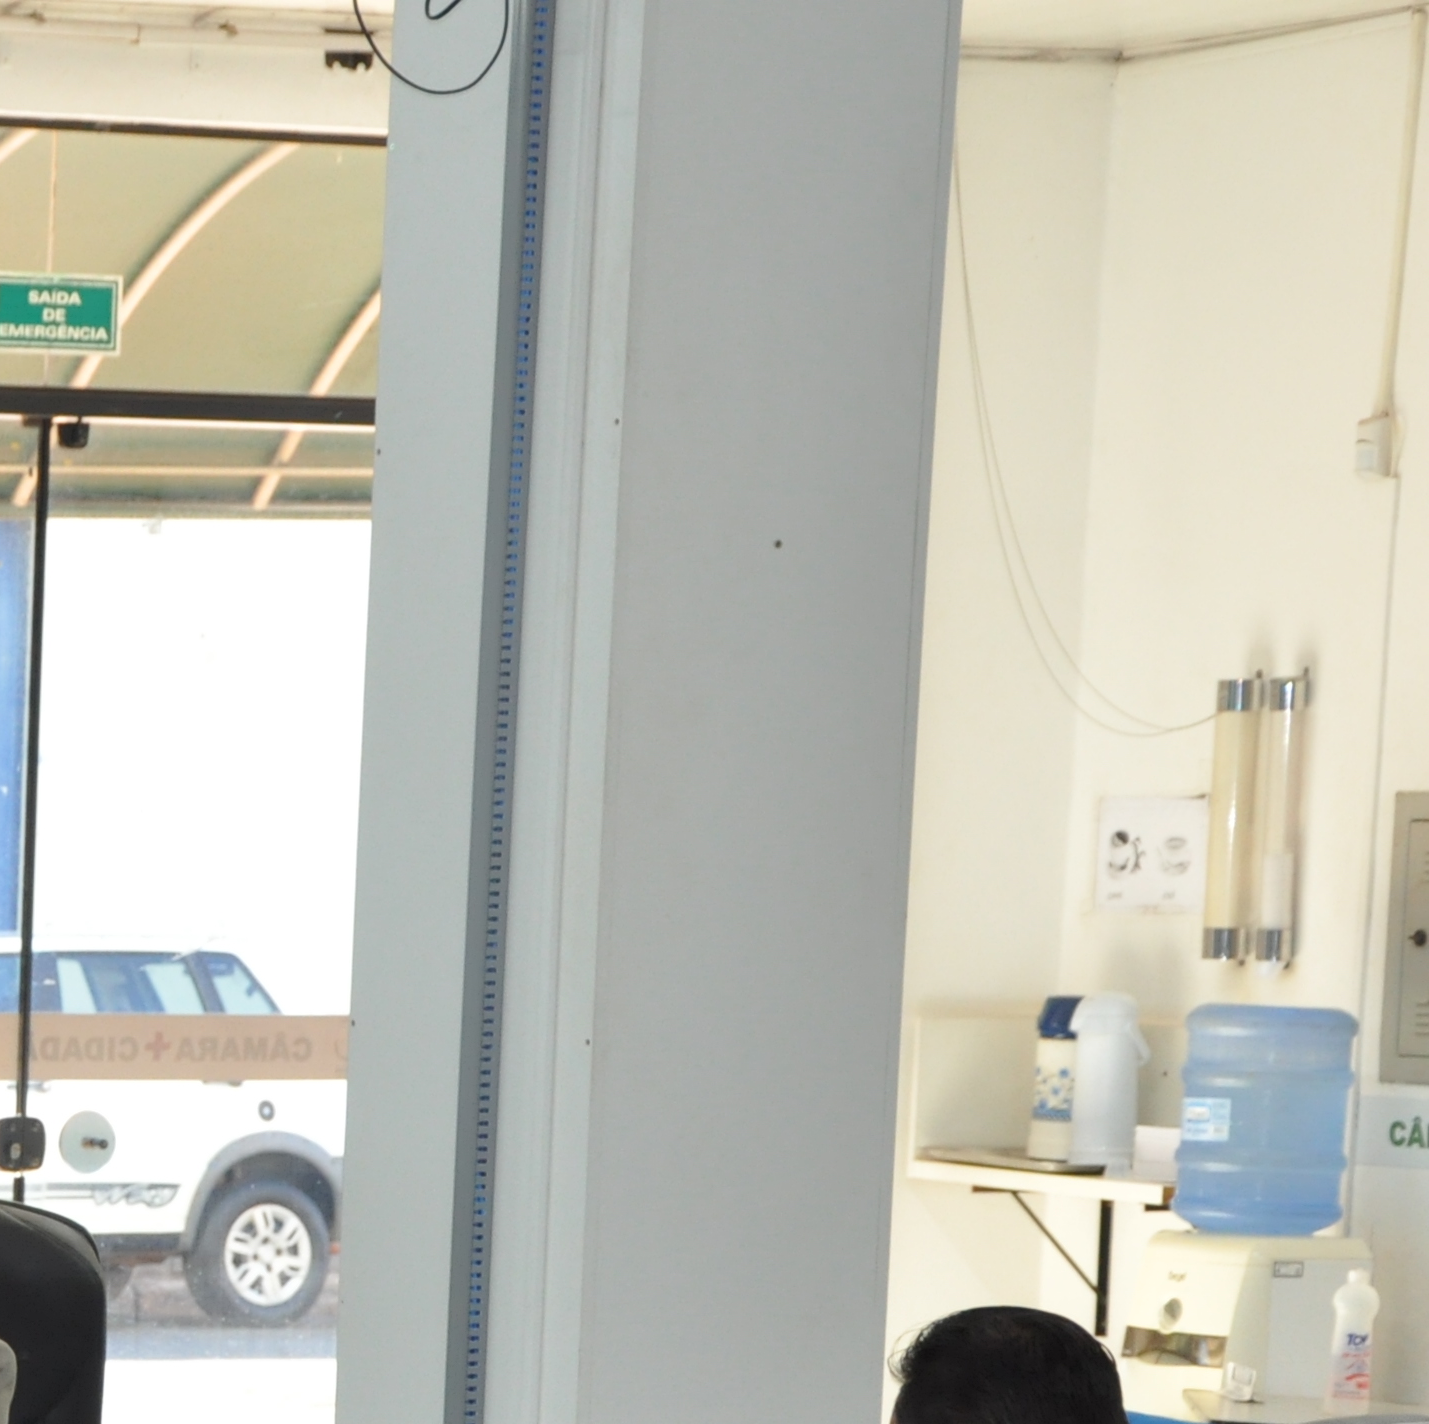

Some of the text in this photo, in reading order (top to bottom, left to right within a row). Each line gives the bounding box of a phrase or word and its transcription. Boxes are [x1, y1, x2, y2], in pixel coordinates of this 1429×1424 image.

[28, 287, 81, 306] SAÍDA
[43, 308, 66, 322] DE
[0, 322, 108, 340] EMERGÊNCIA
